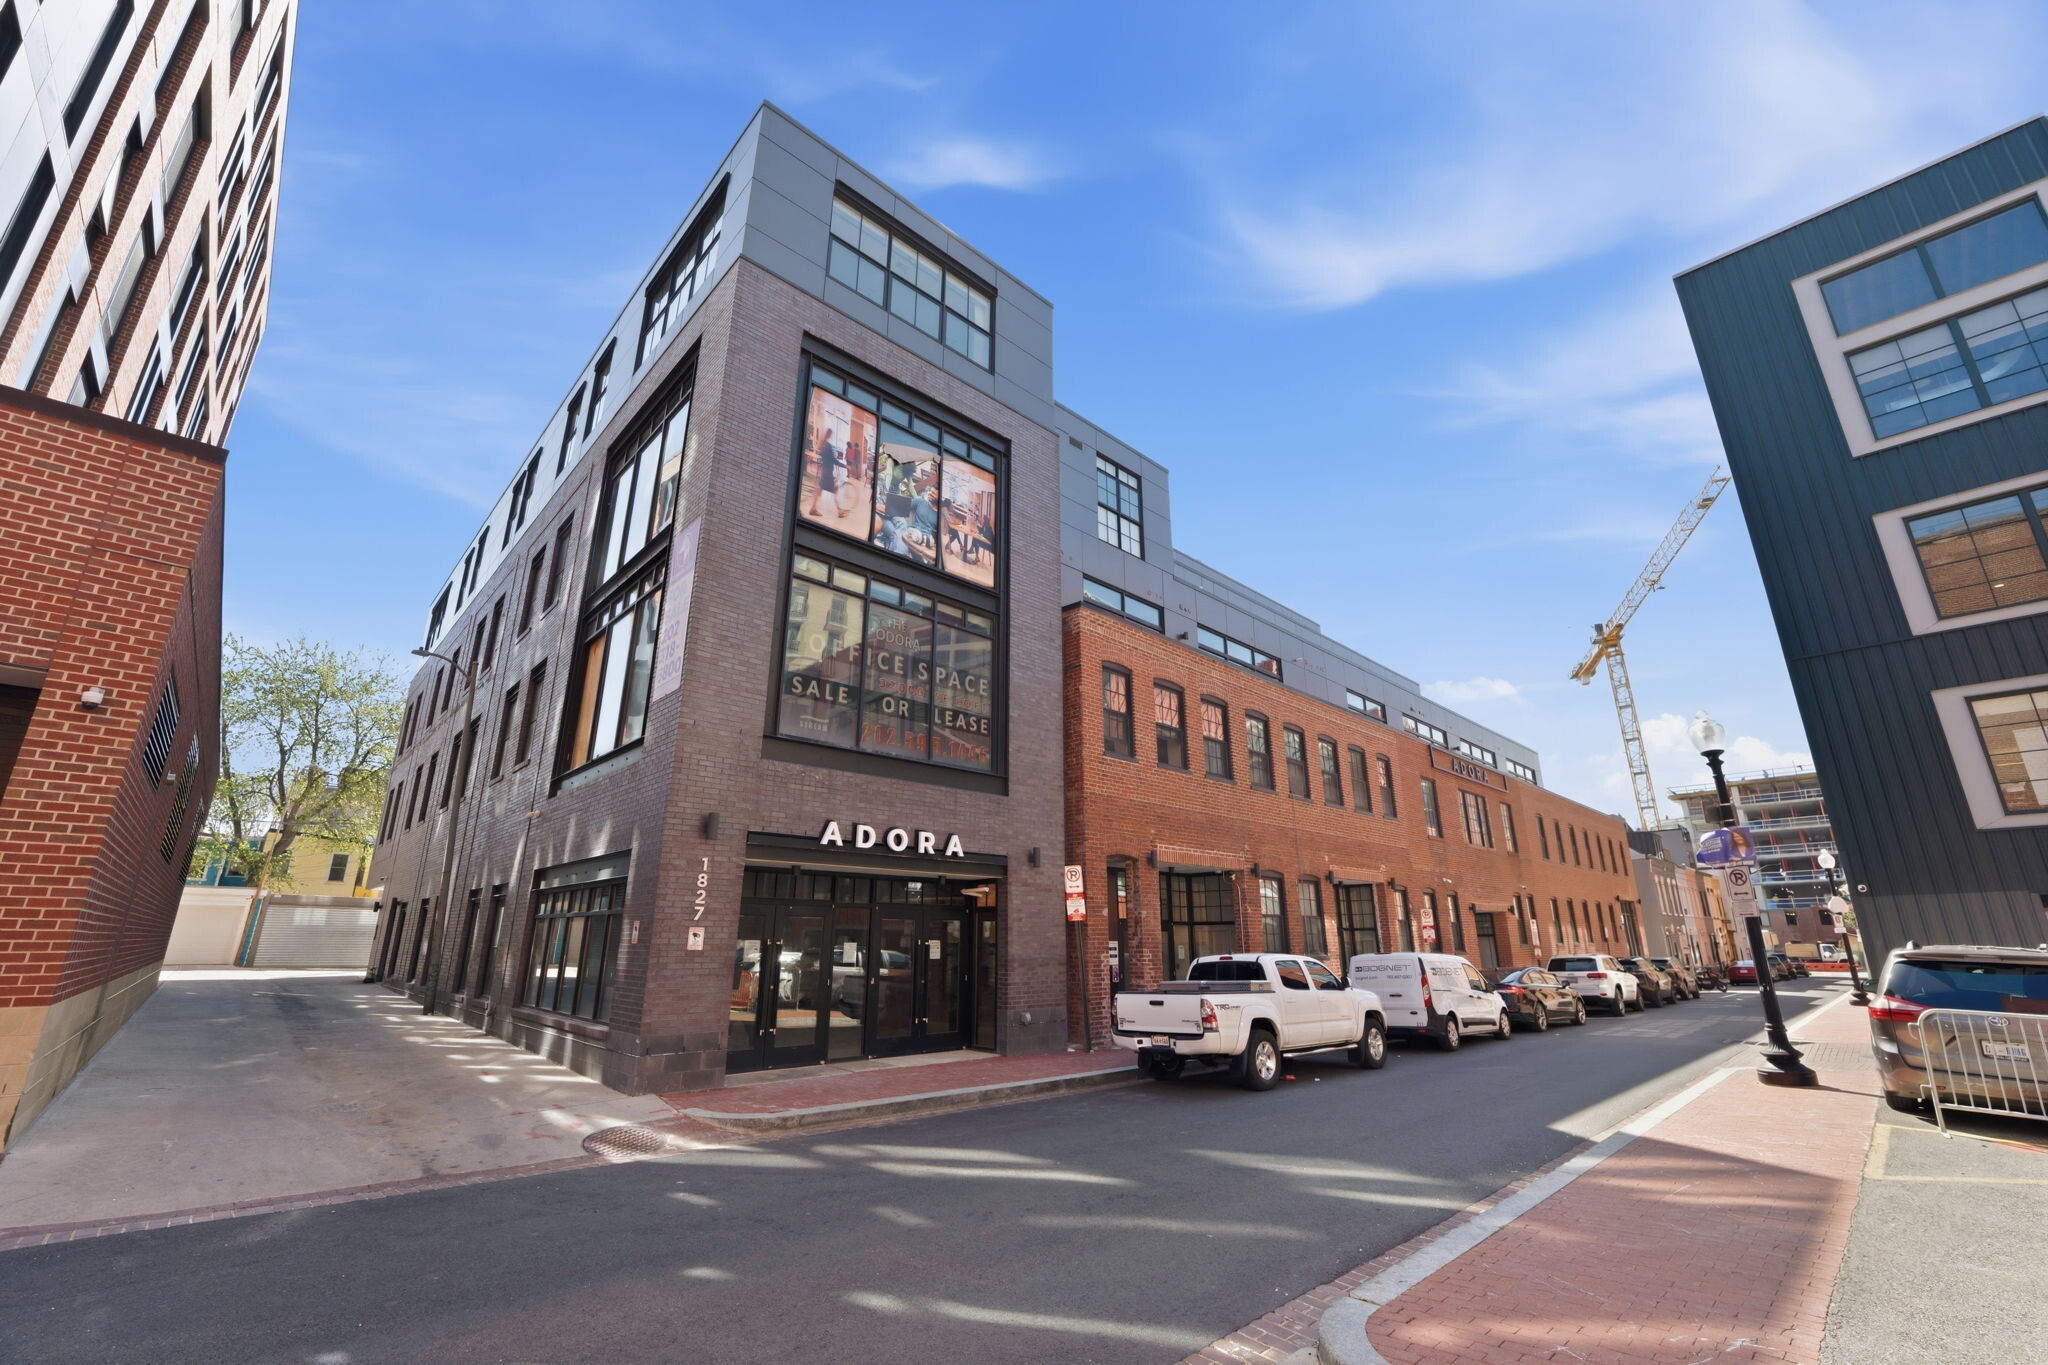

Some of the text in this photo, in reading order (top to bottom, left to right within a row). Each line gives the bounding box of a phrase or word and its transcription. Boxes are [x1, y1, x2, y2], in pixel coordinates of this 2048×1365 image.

[809, 634, 988, 696] OFFICE SPACE
[791, 676, 989, 734] SALE OR LEASE
[1453, 758, 1488, 783] ADORA
[820, 820, 964, 857] ADORA
[693, 857, 709, 921] 1827
